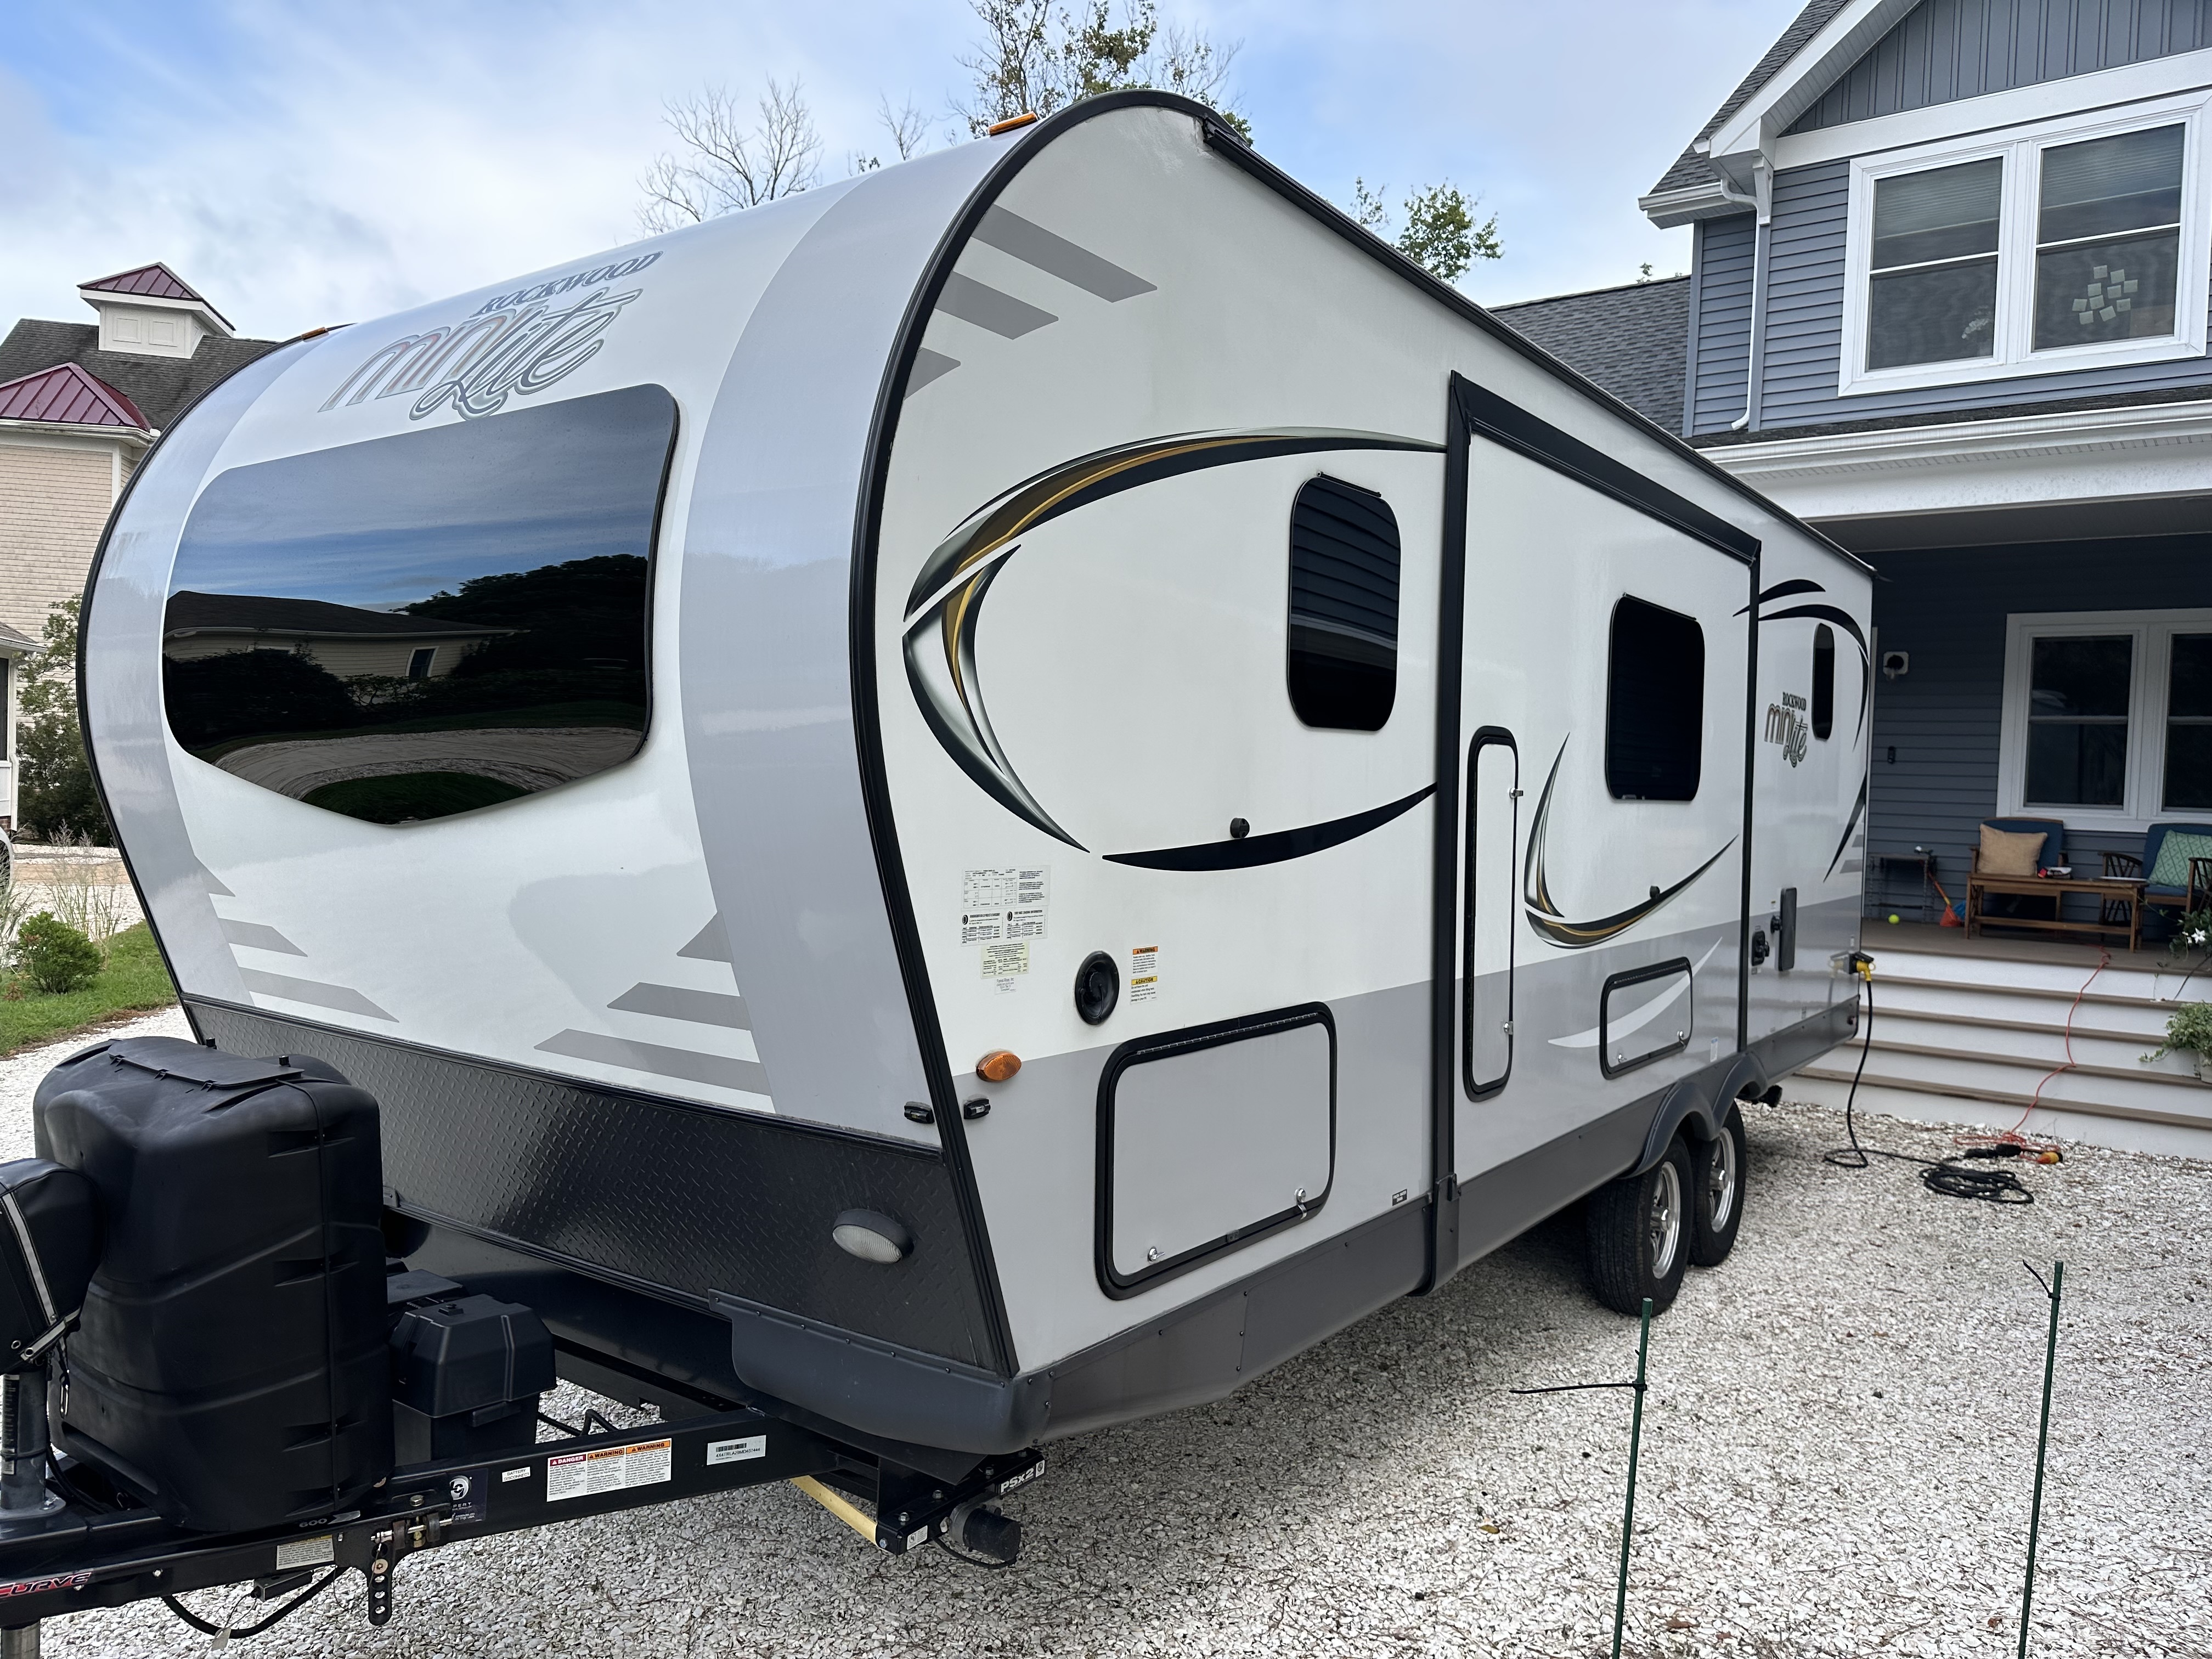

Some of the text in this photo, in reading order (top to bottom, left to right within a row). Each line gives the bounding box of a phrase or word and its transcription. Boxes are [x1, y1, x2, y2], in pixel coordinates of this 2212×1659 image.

[471, 251, 665, 318] ROCKWOOD
[1782, 691, 1807, 712] ROCKWOOD
[636, 1442, 665, 1451] WARNING
[594, 1449, 623, 1458] WARNING
[557, 1455, 584, 1464] DANGER
[504, 1472, 529, 1481] DISCONNECT
[1001, 1468, 1034, 1493] PSx2
[299, 1518, 328, 1528] 600
